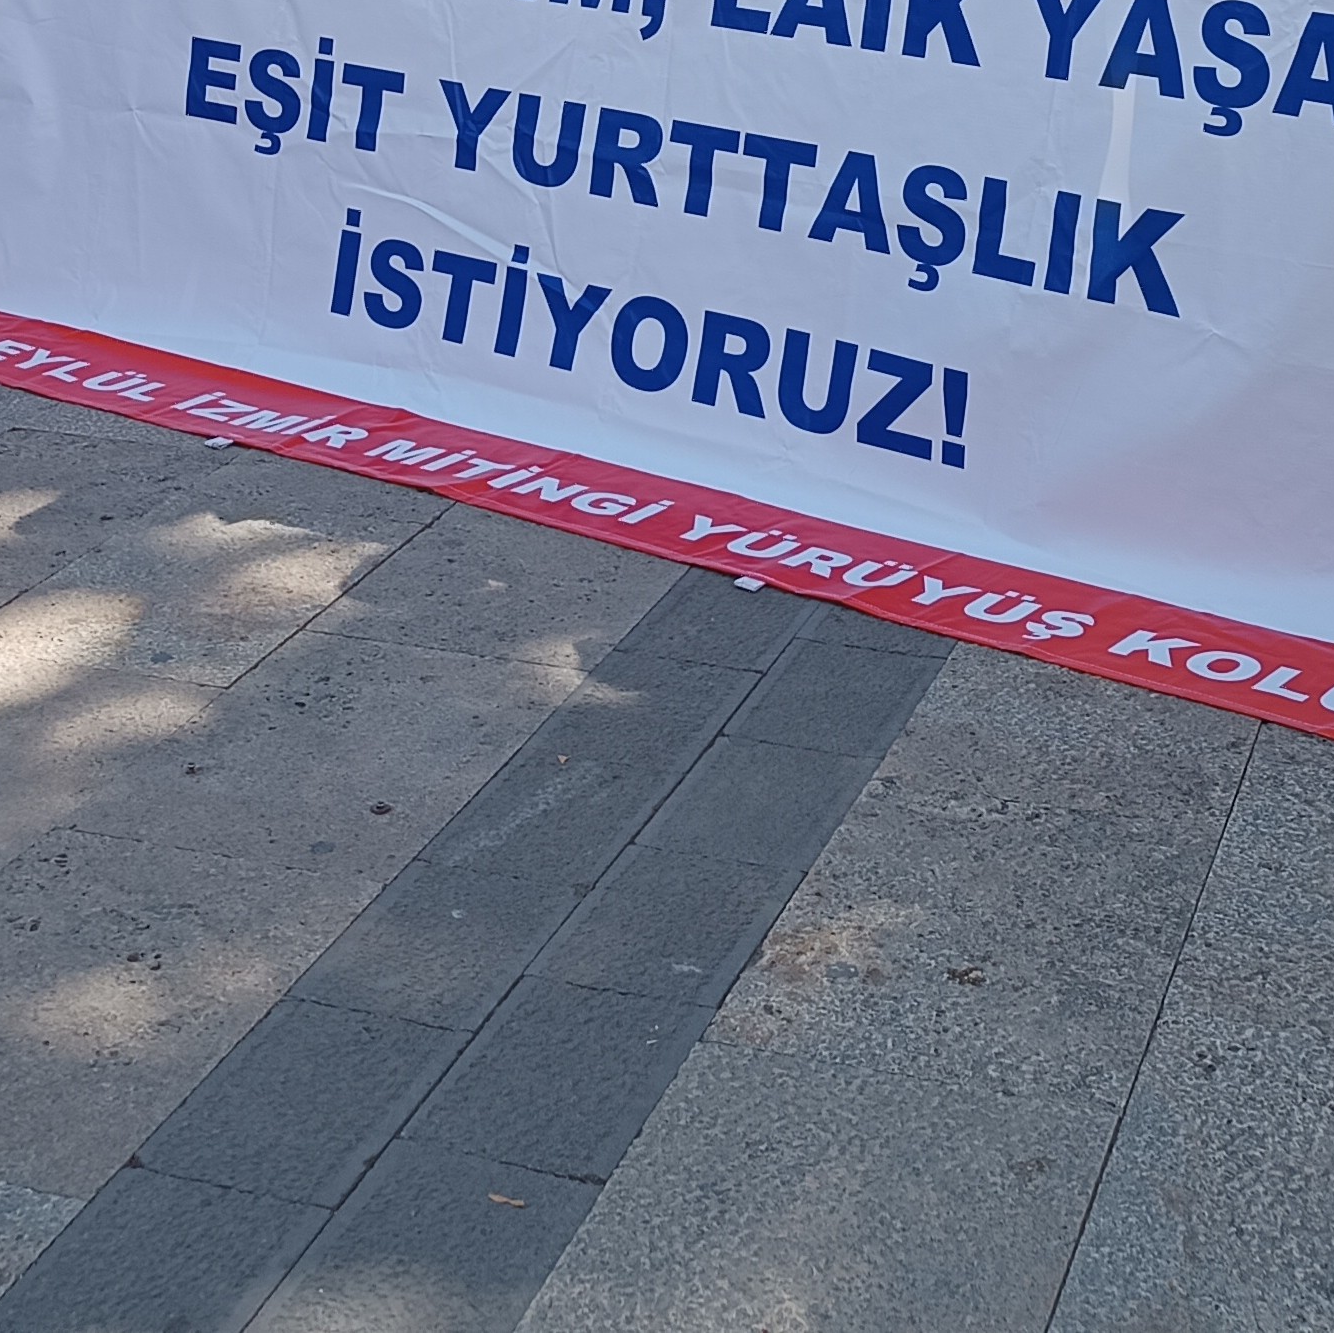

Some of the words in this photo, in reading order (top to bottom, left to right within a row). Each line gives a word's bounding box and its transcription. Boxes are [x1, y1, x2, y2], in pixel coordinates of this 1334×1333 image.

[186, 36, 406, 156] EŞİT
[438, 78, 1185, 319] YURTTAŞLIK
[330, 208, 970, 470] İSTİYORUZ!
[171, 392, 370, 450] İZMİR
[364, 437, 670, 526] MİTİNGİ
[678, 513, 1096, 641] YÜRÜYÜŞ
